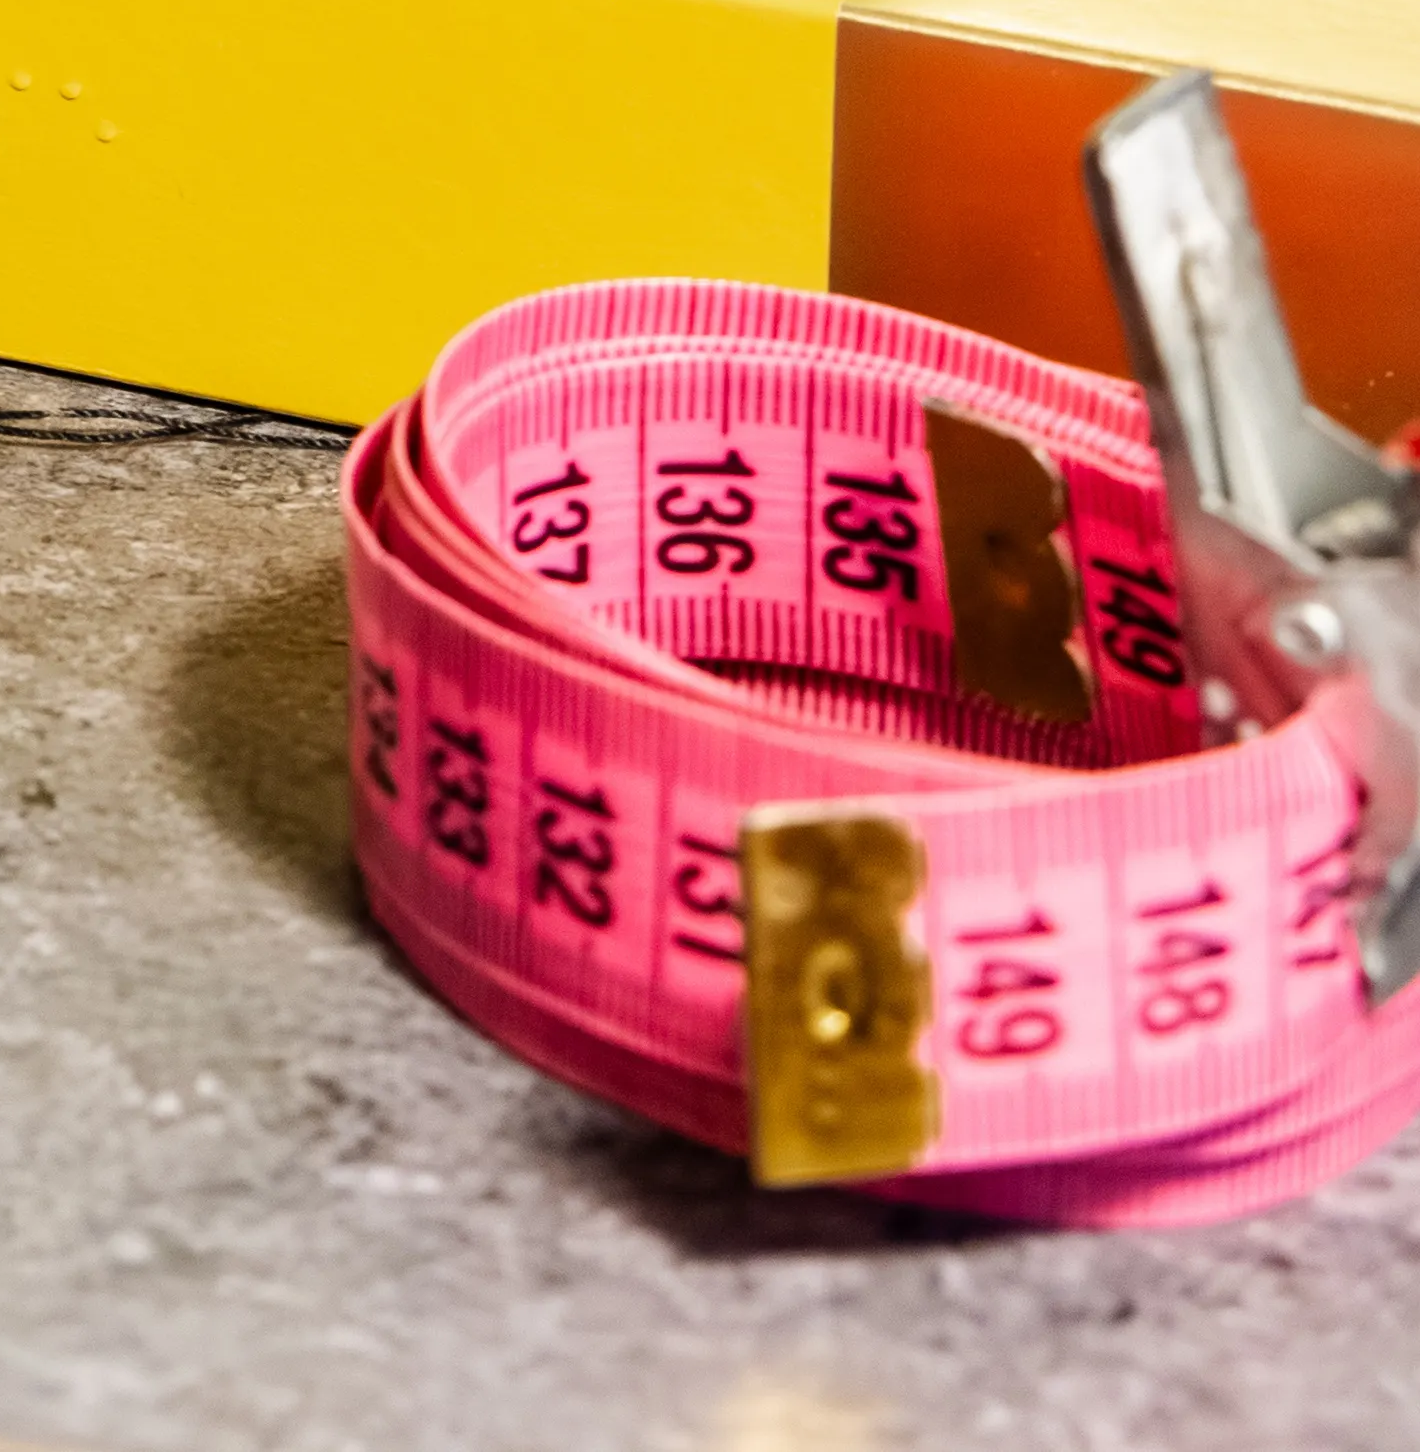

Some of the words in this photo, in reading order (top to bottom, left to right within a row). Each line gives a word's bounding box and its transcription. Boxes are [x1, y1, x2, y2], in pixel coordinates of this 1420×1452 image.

[512, 461, 591, 585] 137
[656, 449, 755, 576] 136
[821, 470, 922, 603] 135
[1089, 556, 1186, 687] 149
[425, 718, 490, 868] 133
[534, 781, 618, 928] 132
[956, 906, 1061, 1060] 149
[1135, 874, 1229, 1036] 148
